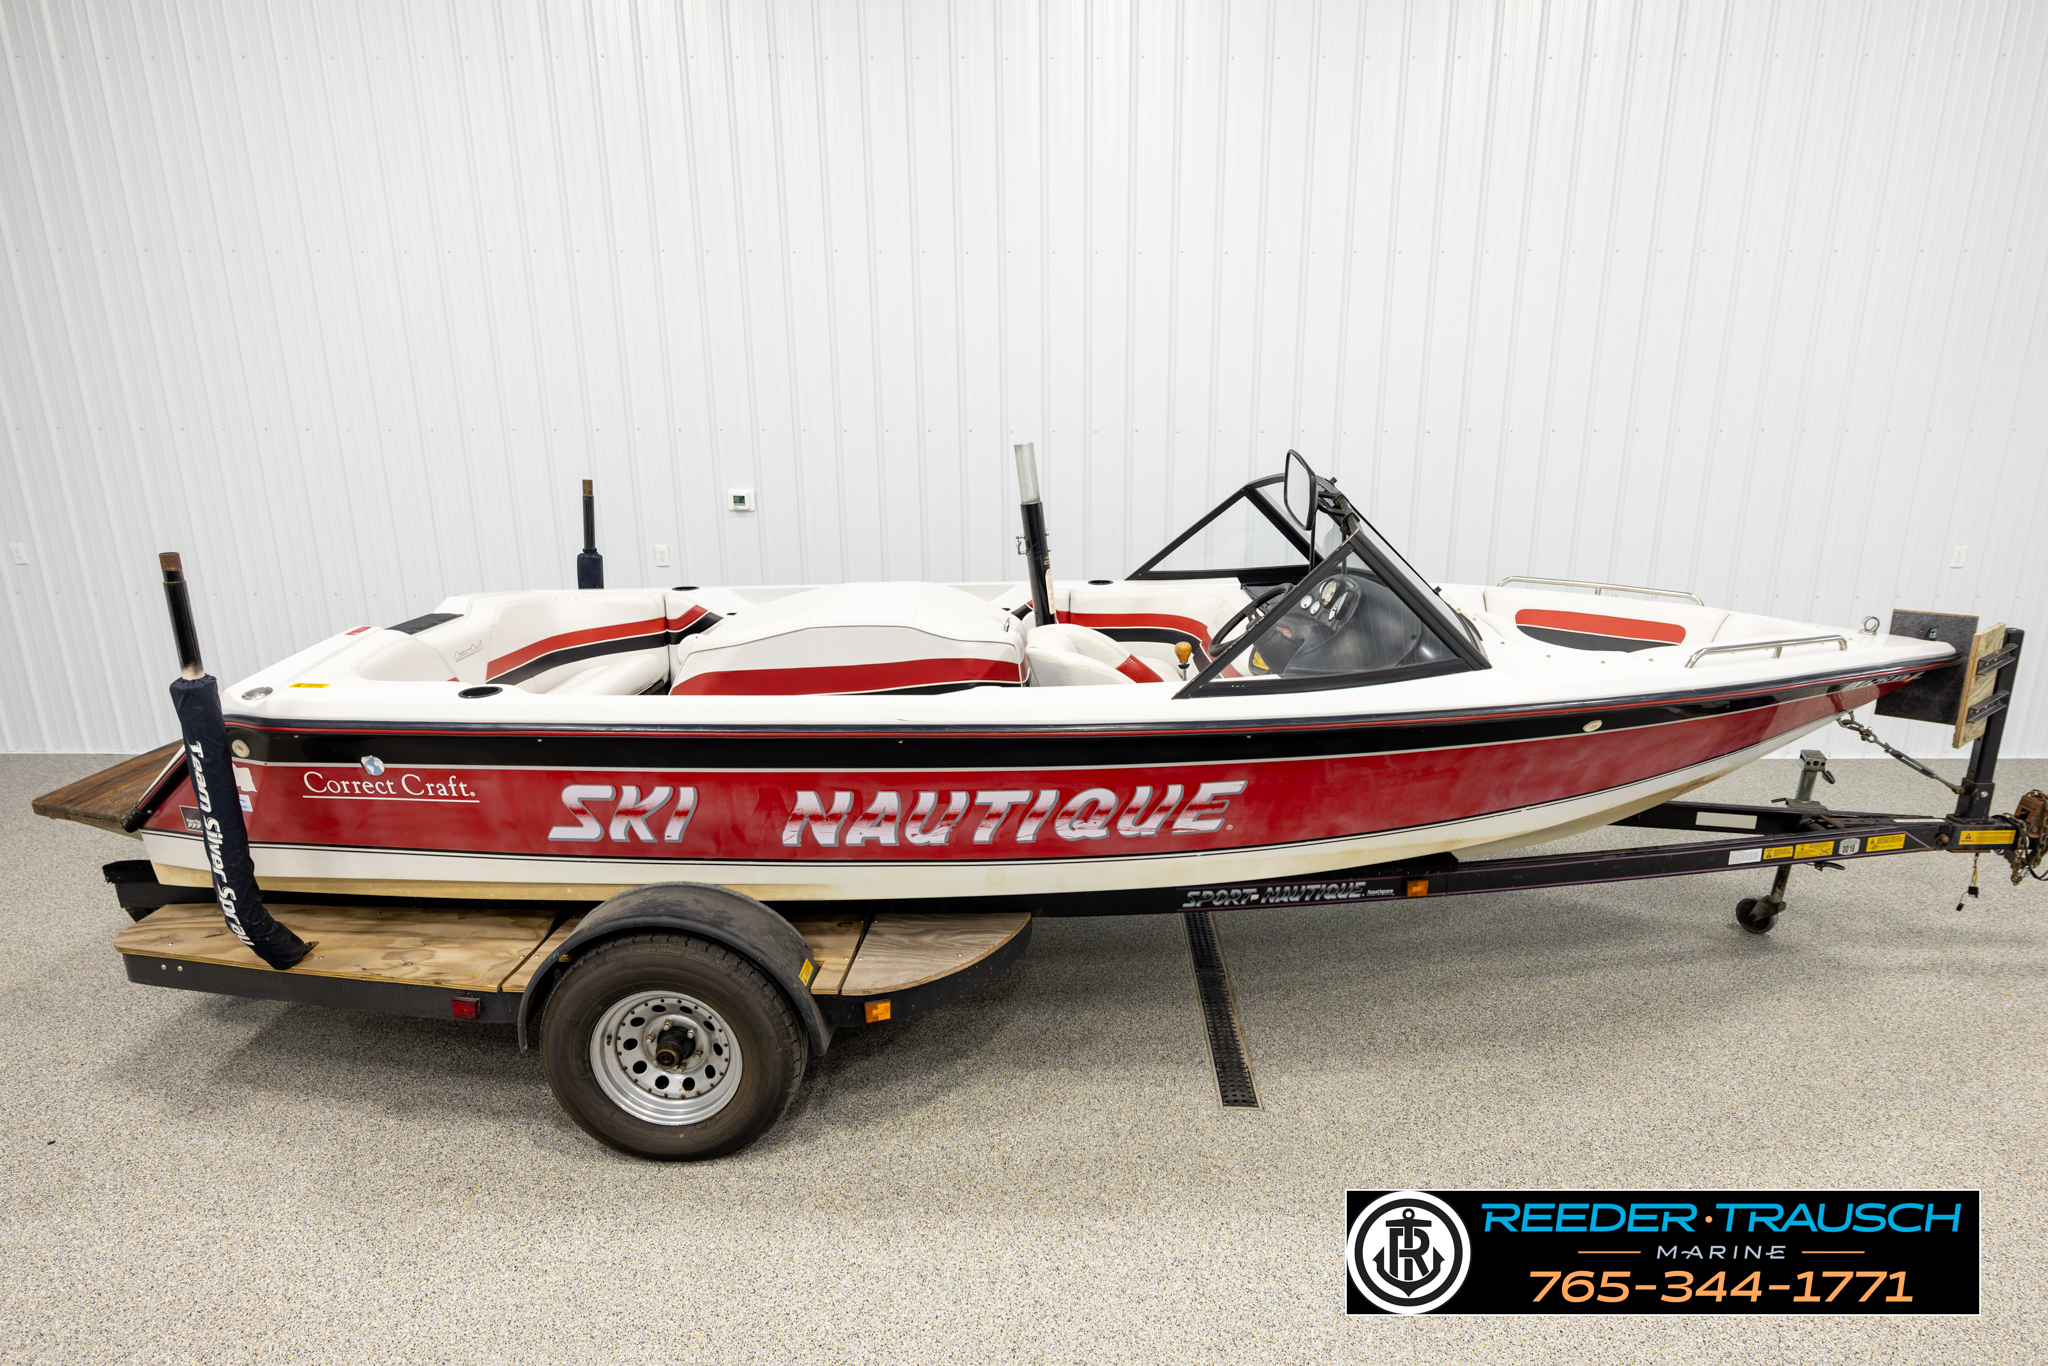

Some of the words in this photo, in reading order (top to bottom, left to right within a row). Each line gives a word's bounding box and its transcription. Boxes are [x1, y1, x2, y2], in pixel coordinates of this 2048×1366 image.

[303, 771, 397, 795] Correct
[191, 740, 212, 813] Team
[203, 816, 228, 884] Silver
[547, 784, 698, 843] SKI
[782, 780, 1248, 847] NAUTIQUE
[1182, 888, 1258, 908] SPORT
[1260, 881, 1366, 904] NAUTIQUE
